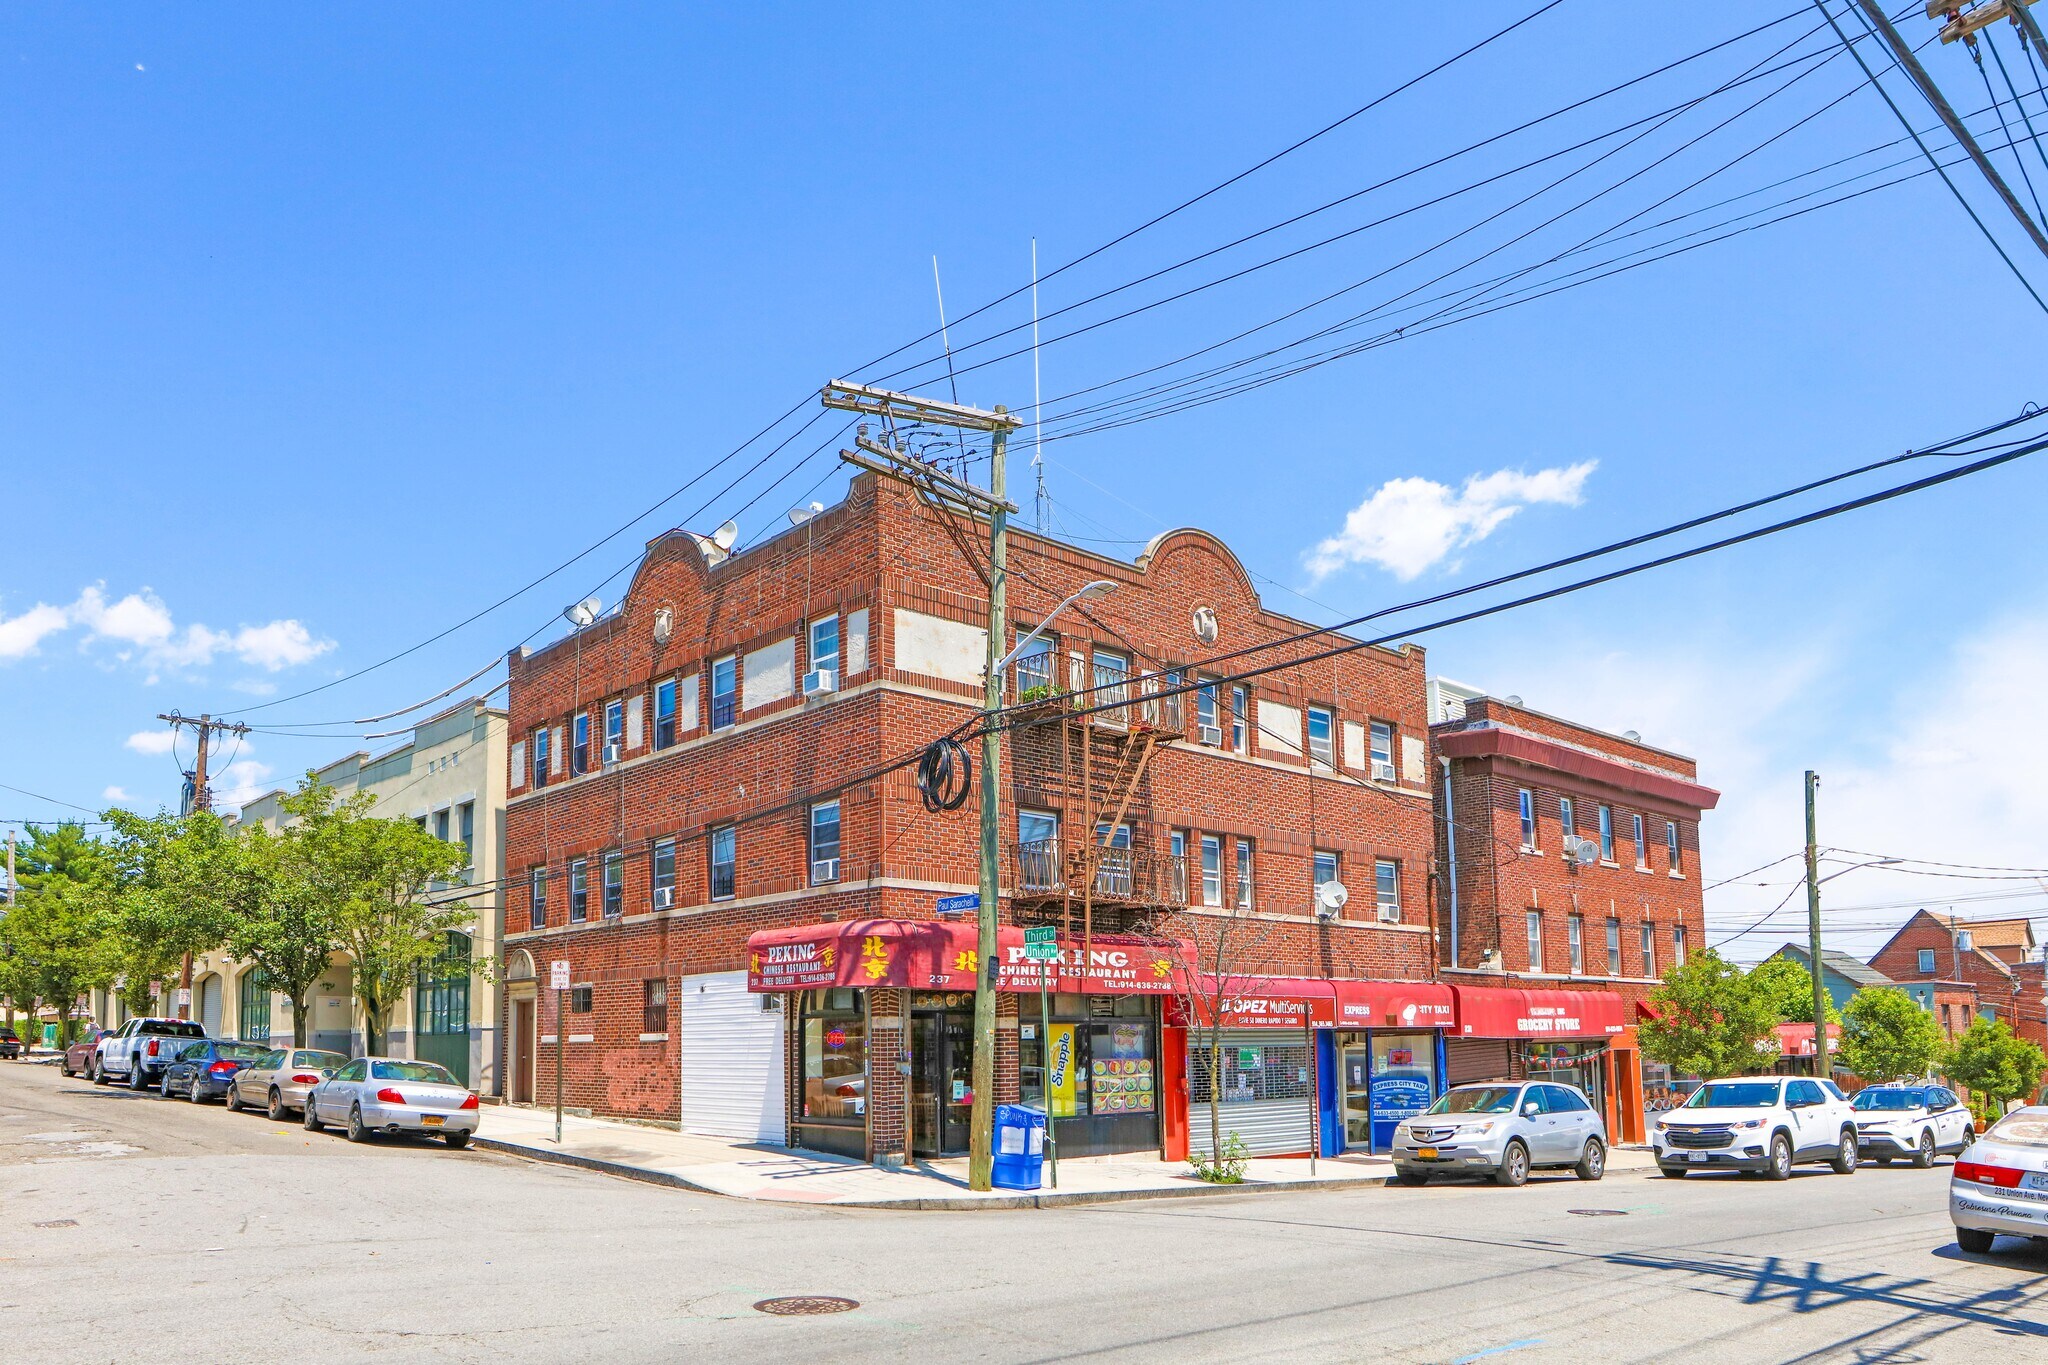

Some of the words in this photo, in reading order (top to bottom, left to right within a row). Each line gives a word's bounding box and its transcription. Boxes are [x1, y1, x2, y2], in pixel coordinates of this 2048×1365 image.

[938, 900, 949, 911] Paul
[1025, 931, 1048, 942] Third
[768, 943, 816, 963] PEKING
[822, 946, 835, 968] 京
[1007, 946, 1129, 968] PKING
[1026, 945, 1051, 957] Union
[861, 936, 890, 979] 北京
[954, 950, 978, 972] 北
[763, 964, 784, 975] CHINESE
[786, 961, 821, 974] RESTAURANT
[999, 965, 1051, 976] CHINESE
[1059, 967, 1137, 979] RESTAURANT
[763, 977, 774, 986] FREE
[929, 975, 950, 984] 237
[1012, 978, 1058, 986] DELVRY
[1269, 999, 1314, 1015] MultiServics
[1344, 1005, 1370, 1015] EXPRESS
[1434, 1005, 1450, 1014] TAXI
[1517, 1018, 1553, 1031] GROCERY
[1555, 1018, 1580, 1031] STORE
[1051, 1032, 1071, 1087] Snapple
[1373, 1081, 1398, 1091] EXPRESS
[1412, 1082, 1426, 1090] TAXI
[1994, 1187, 2005, 1196] 231
[2006, 1188, 2023, 1198] Union
[2024, 1190, 2036, 1199] Ave.
